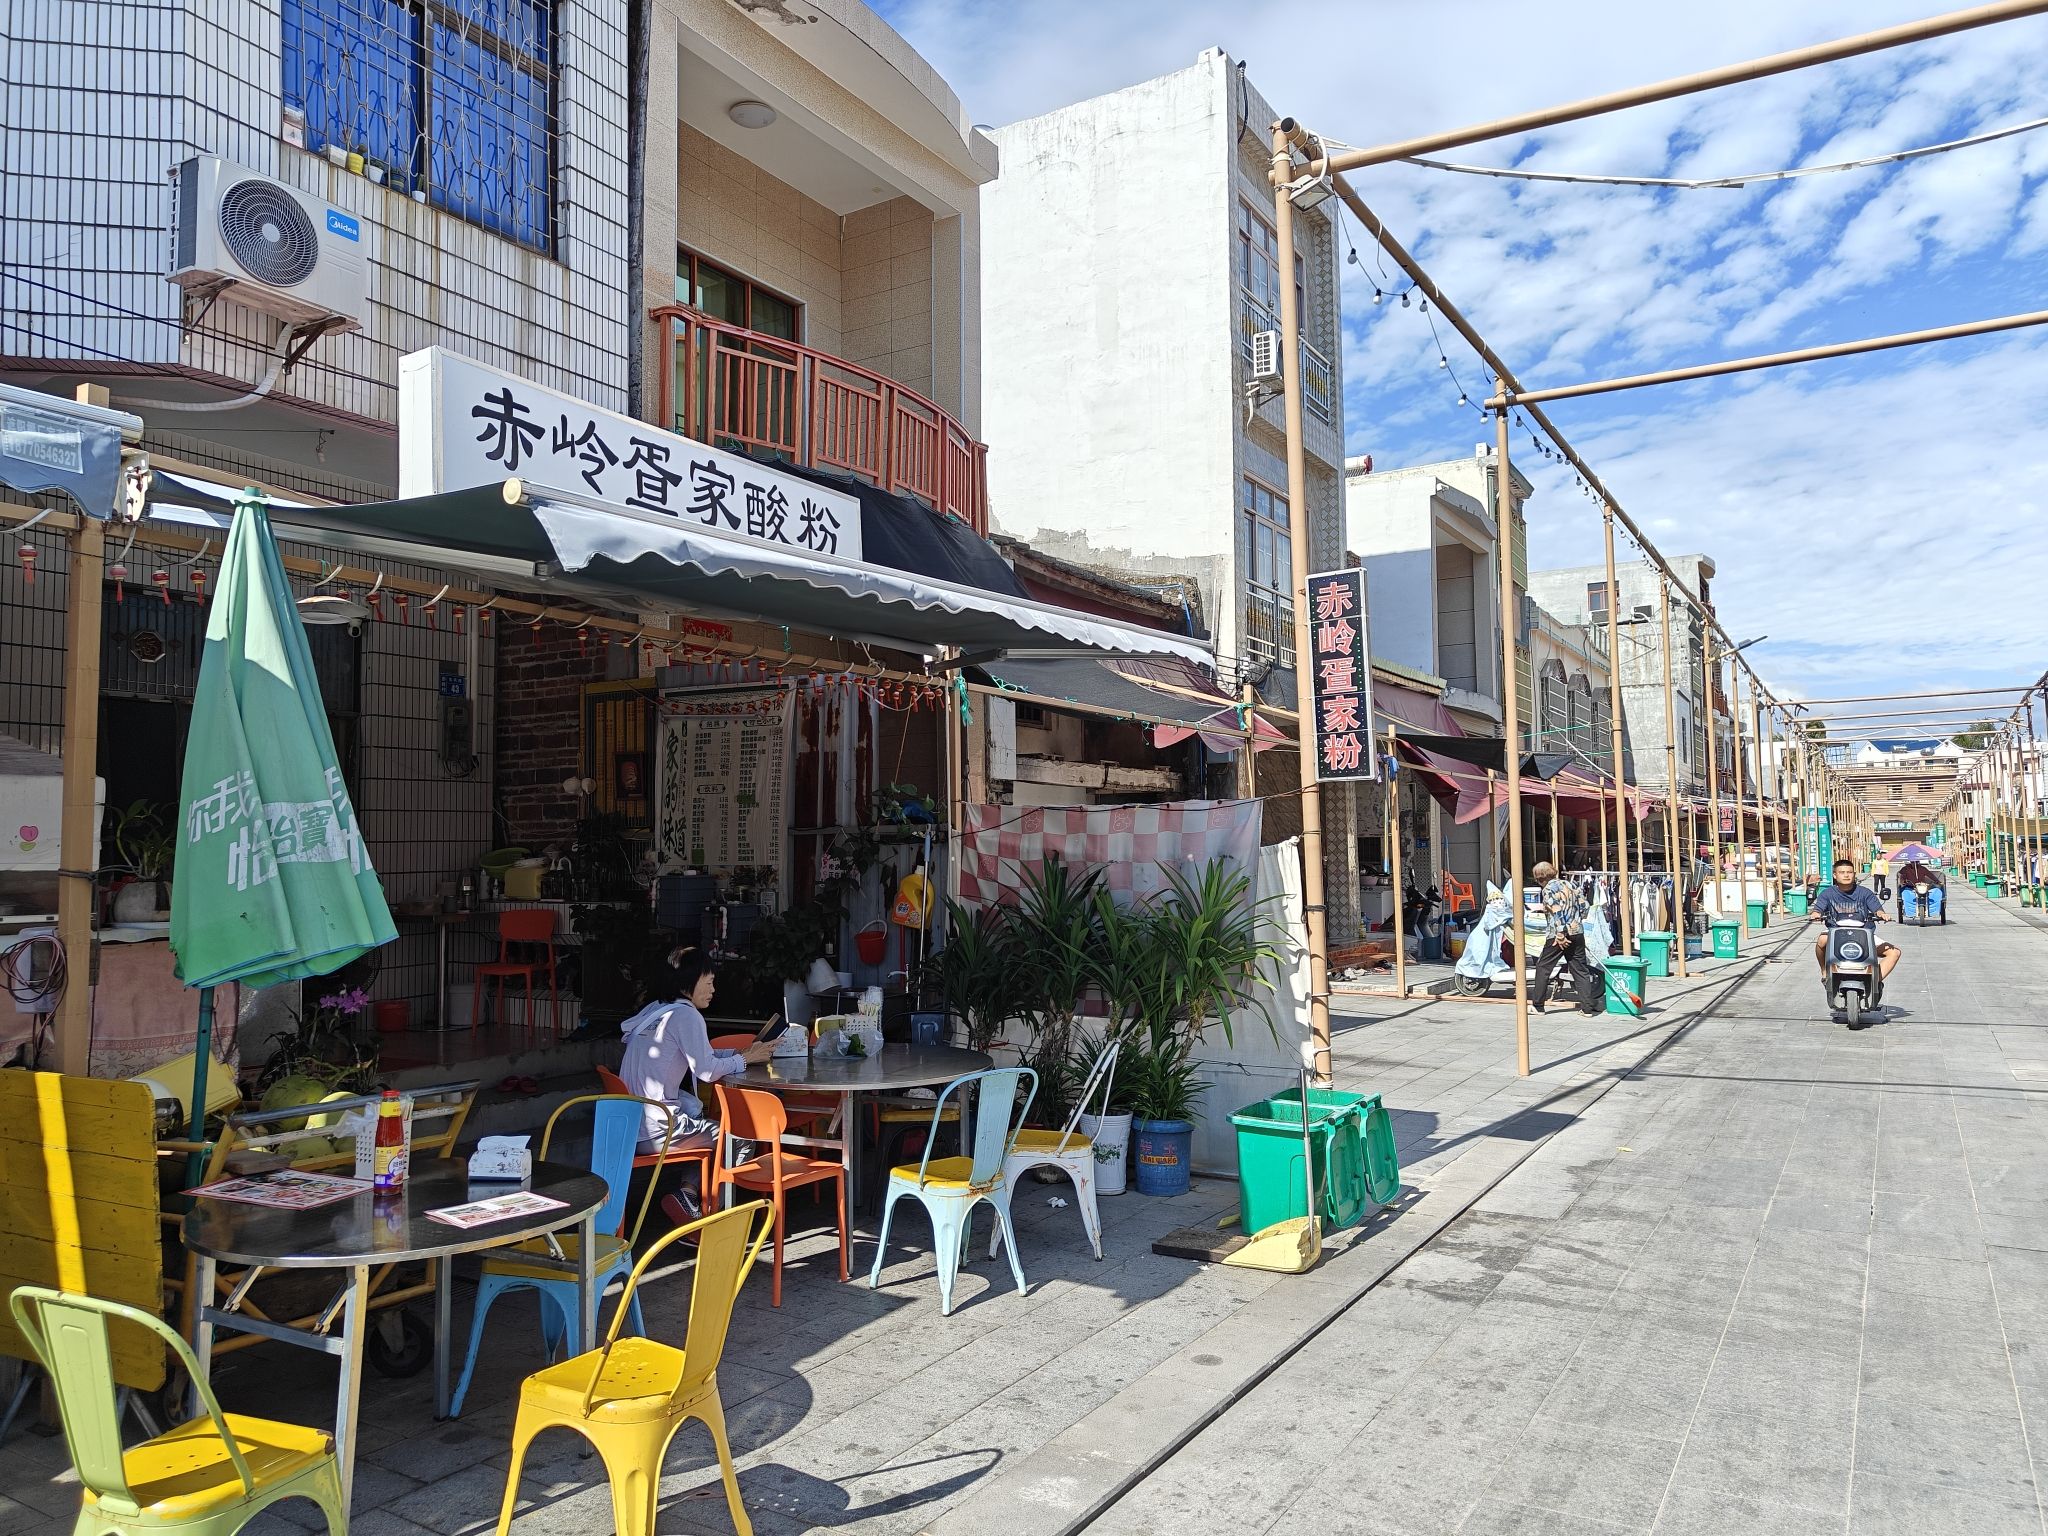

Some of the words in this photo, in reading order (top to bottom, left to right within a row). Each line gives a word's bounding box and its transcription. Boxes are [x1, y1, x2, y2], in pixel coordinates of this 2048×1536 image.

[331, 218, 358, 236] Midea
[471, 386, 840, 555] 赤岭疍家酸粉
[450, 684, 460, 694] 43
[1316, 581, 1363, 771] 赤岭疍家粉
